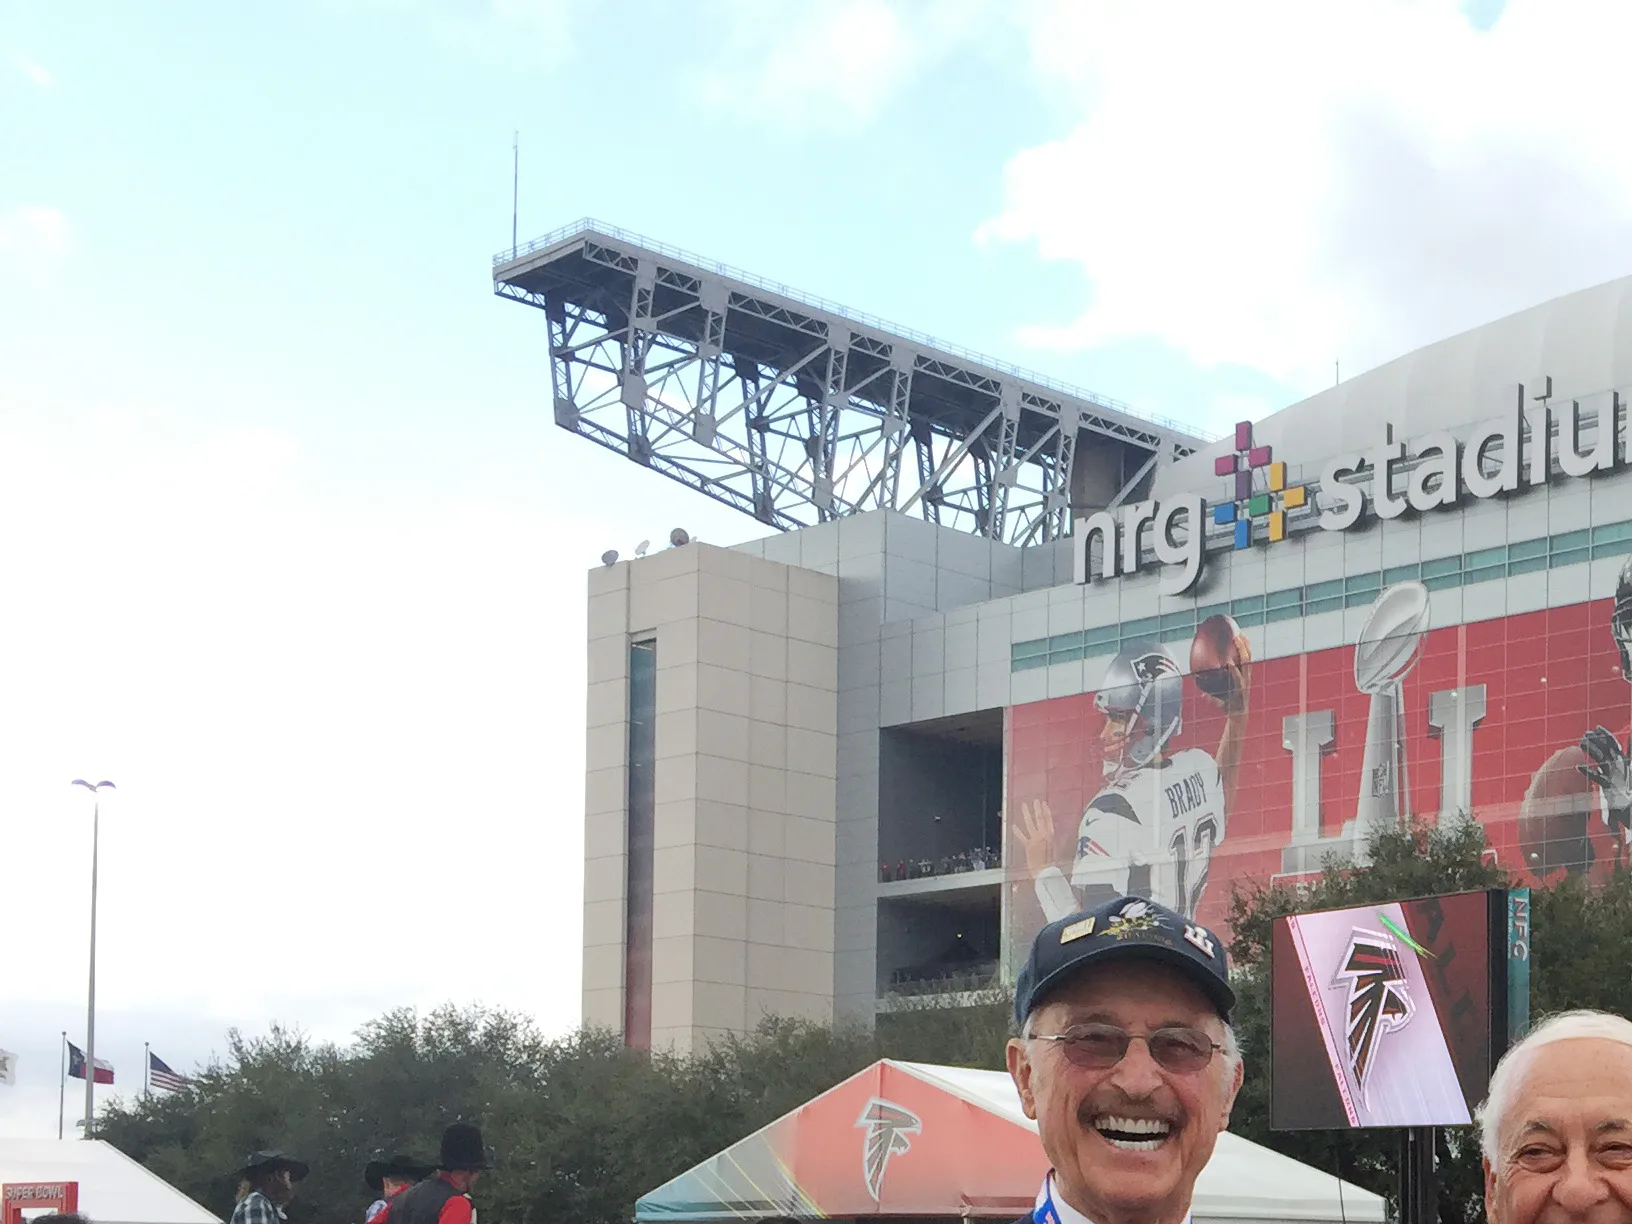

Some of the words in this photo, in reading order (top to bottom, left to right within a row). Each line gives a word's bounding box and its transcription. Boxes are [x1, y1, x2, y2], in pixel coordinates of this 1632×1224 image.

[1073, 489, 1206, 596] nrg
[1165, 771, 1208, 819] BRADY
[1513, 897, 1529, 962] NFC
[6, 1186, 34, 1201] SUPER
[35, 1185, 64, 1199] BOWL
